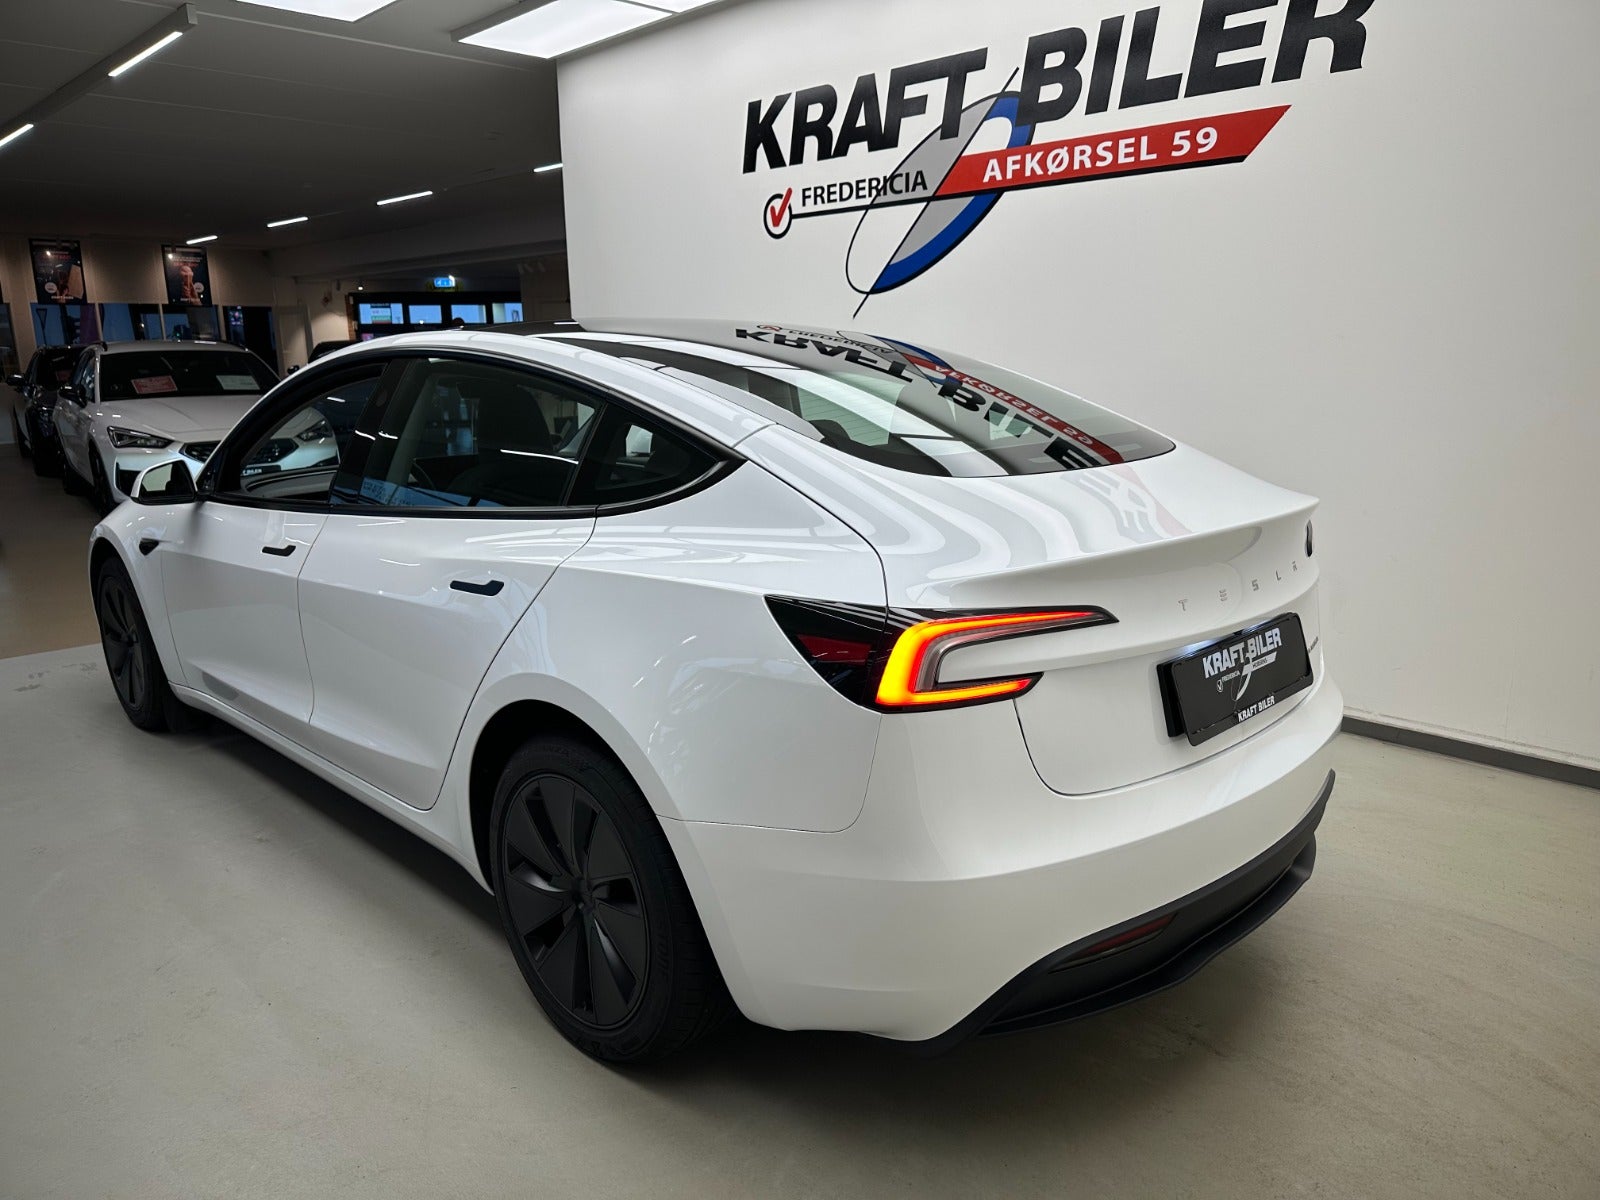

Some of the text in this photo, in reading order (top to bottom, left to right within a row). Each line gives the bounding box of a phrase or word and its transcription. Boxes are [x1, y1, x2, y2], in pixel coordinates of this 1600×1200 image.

[742, 0, 1375, 174] KRAFT BILER
[982, 126, 1219, 183] AFKØRSEL 59
[801, 170, 928, 207] FREDERICIA
[1178, 560, 1298, 612] TESLA
[1202, 642, 1245, 678] KRAFT
[1247, 627, 1282, 658] BILER
[1238, 696, 1275, 722] KRAFT BILER
